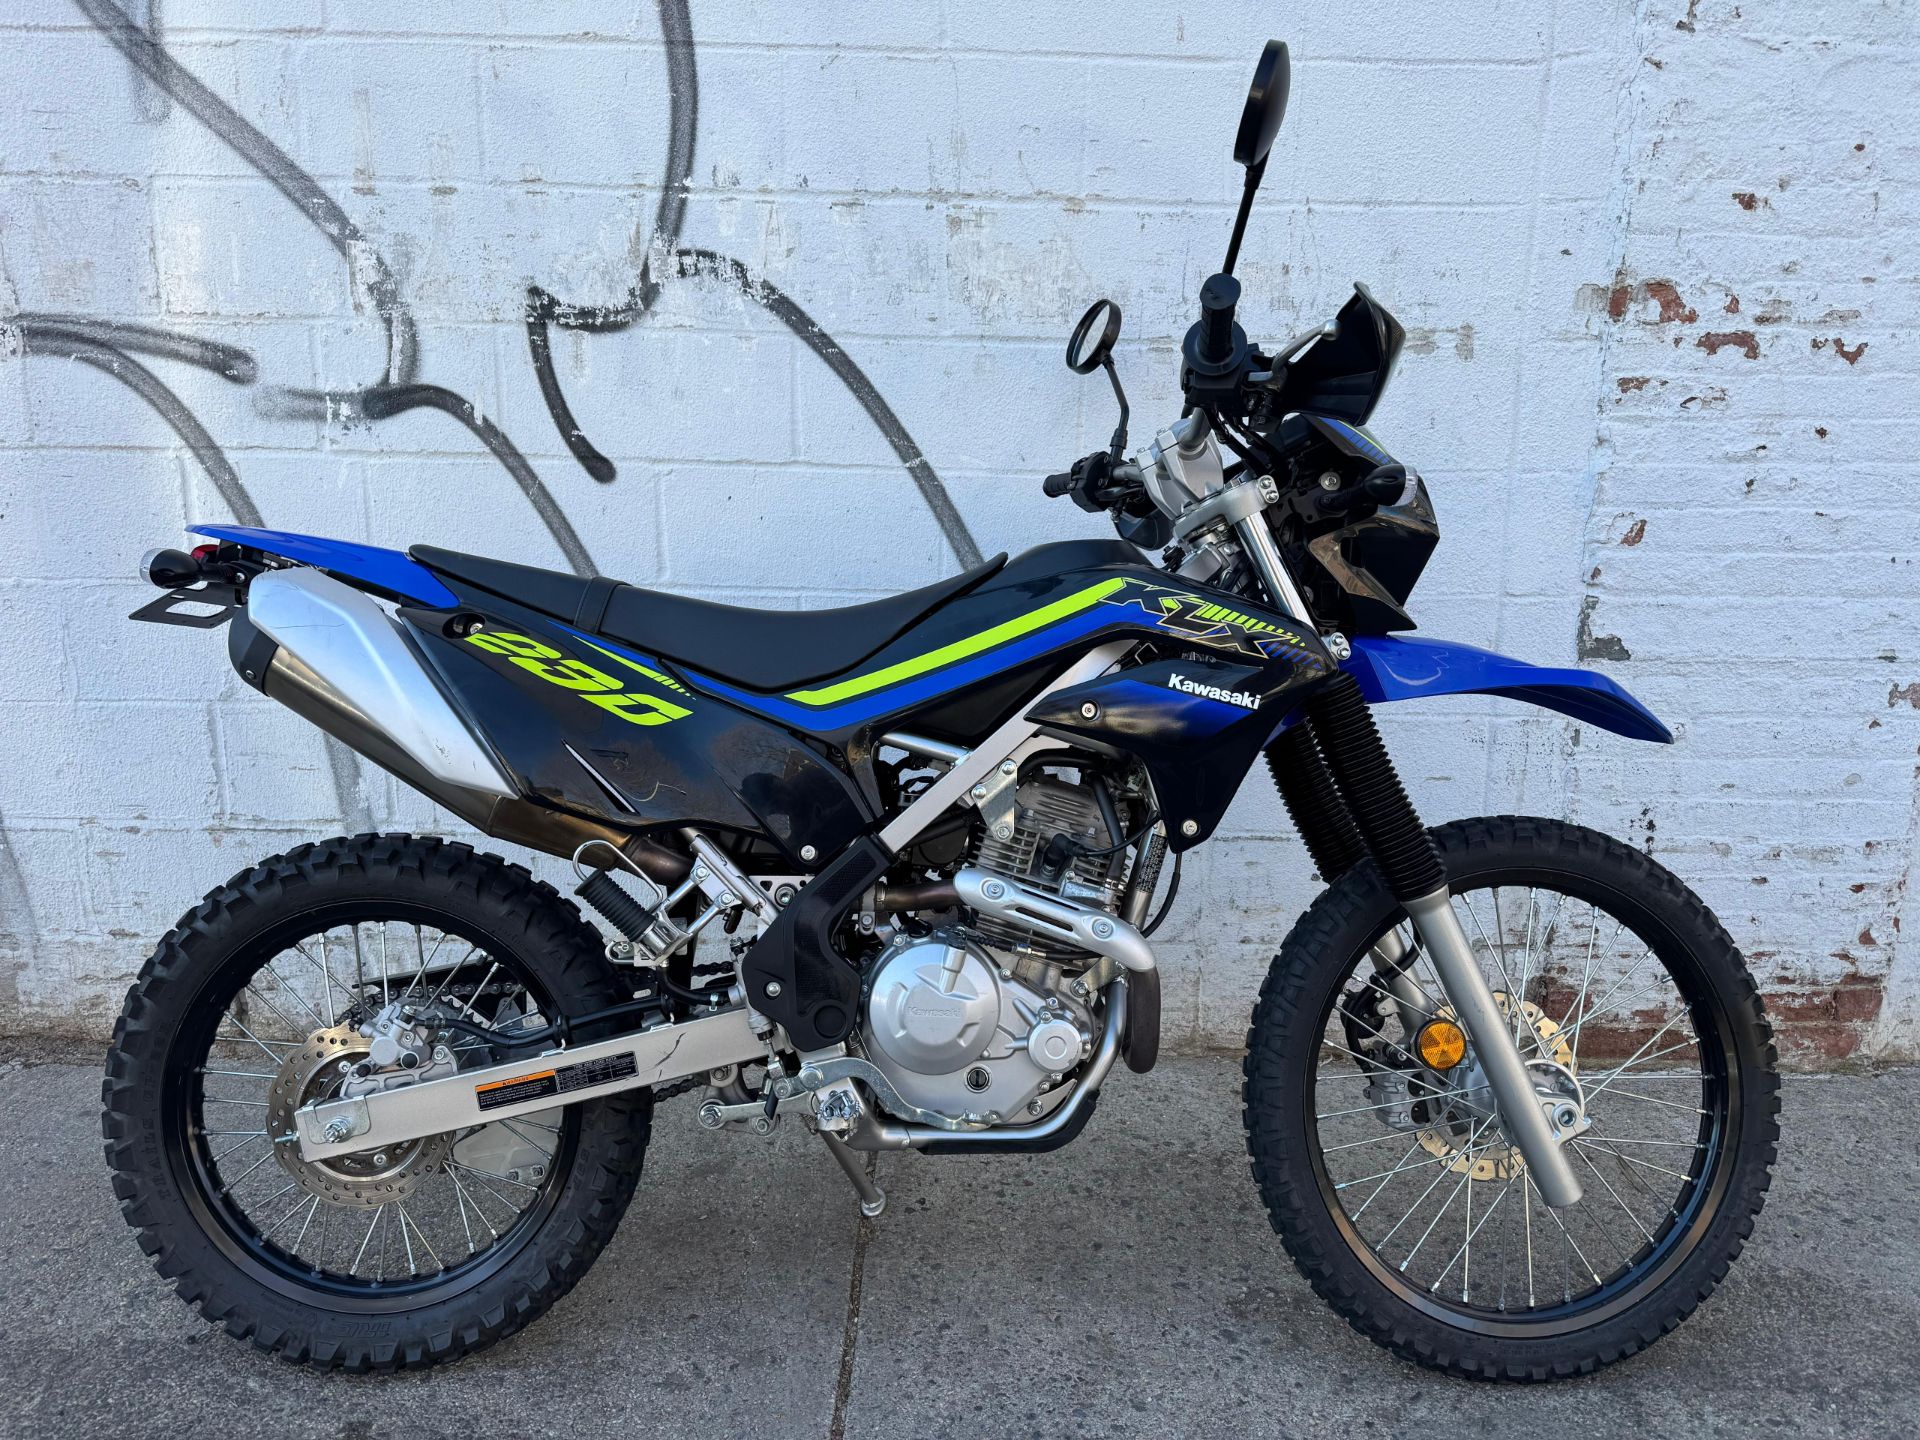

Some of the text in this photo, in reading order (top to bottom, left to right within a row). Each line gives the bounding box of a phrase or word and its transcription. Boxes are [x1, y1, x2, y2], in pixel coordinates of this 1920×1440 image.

[1099, 577, 1293, 659] KLX
[463, 632, 694, 726] 230
[1168, 673, 1262, 709] Kawasaki
